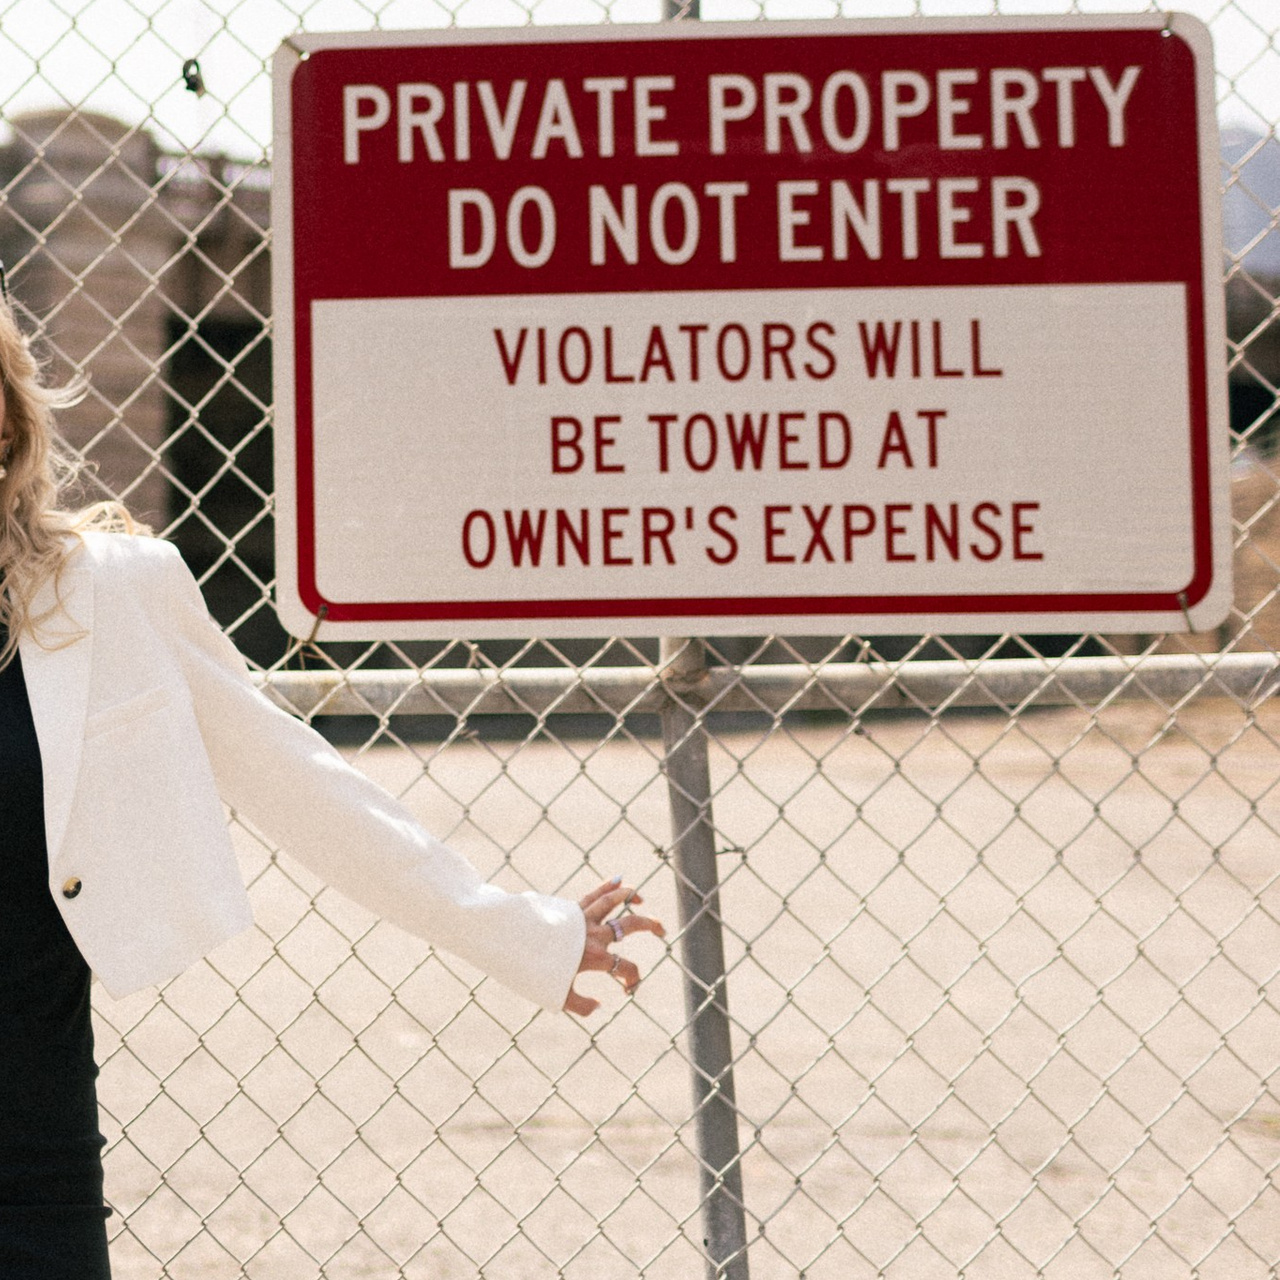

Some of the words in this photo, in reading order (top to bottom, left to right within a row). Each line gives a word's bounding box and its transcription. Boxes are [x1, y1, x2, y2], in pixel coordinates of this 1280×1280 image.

[345, 77, 678, 163] PRIVATE
[710, 68, 1138, 153] PROPERTY
[450, 187, 555, 267] DO
[591, 183, 747, 264] NOT
[779, 178, 1039, 260] ENTER
[494, 321, 836, 385] VIOLATORS
[859, 320, 1002, 378] WILL
[551, 416, 624, 474] BE
[648, 412, 851, 472] TOWED
[878, 410, 946, 468] AT
[462, 506, 738, 568] OWNER'S
[765, 502, 1043, 563] EXPENSE
